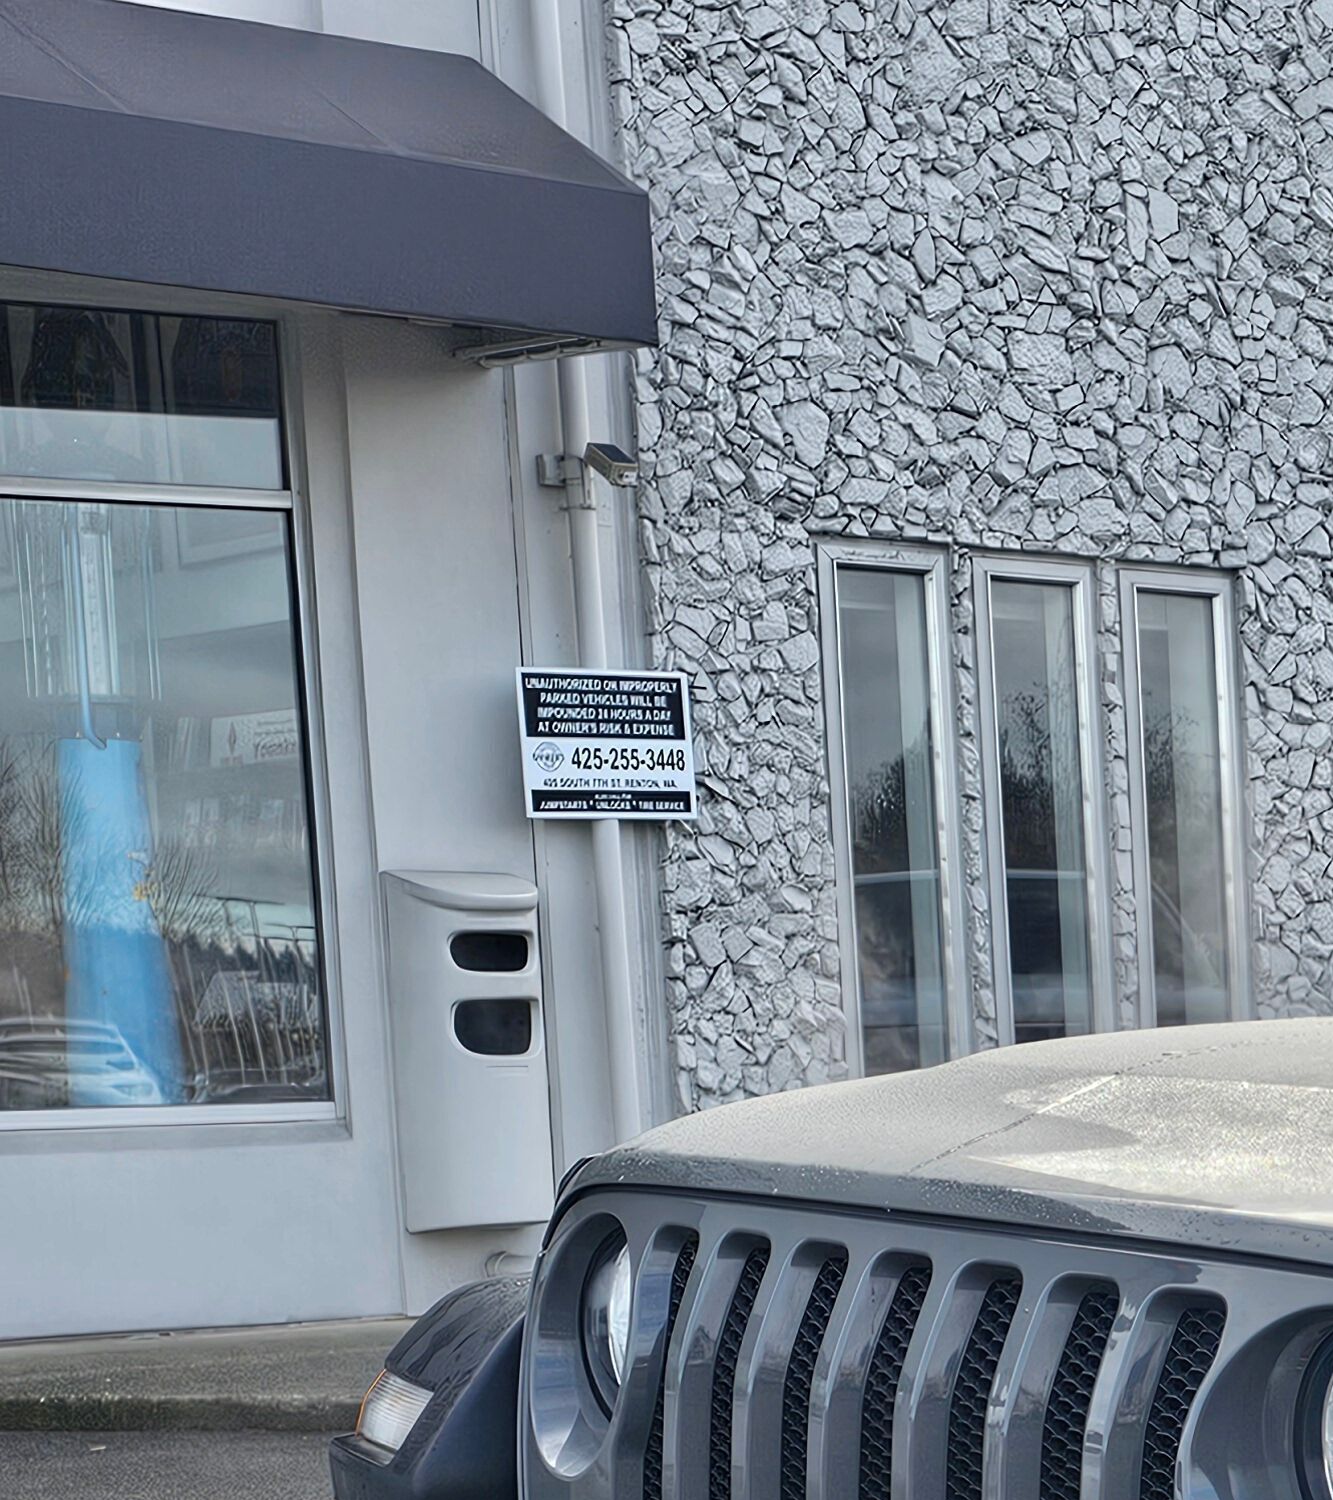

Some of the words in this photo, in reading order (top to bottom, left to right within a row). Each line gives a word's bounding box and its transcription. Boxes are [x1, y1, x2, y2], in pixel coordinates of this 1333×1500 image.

[525, 677, 601, 691] UNAUTHORIZED
[619, 680, 678, 694] IMPROPERLY
[540, 692, 580, 705] PARKED
[581, 693, 629, 706] VEHICLES
[630, 695, 652, 707] WILL
[654, 696, 667, 707] BE
[537, 707, 596, 720] IMPOUNDED
[610, 709, 643, 720] HOURS
[644, 709, 652, 720] A
[653, 710, 671, 721] DAY
[537, 721, 549, 733] AT
[551, 721, 597, 734] OWNER'S
[600, 722, 622, 734] RISK
[632, 723, 675, 736] EXPENSE
[571, 746, 686, 772] 425-255-3448
